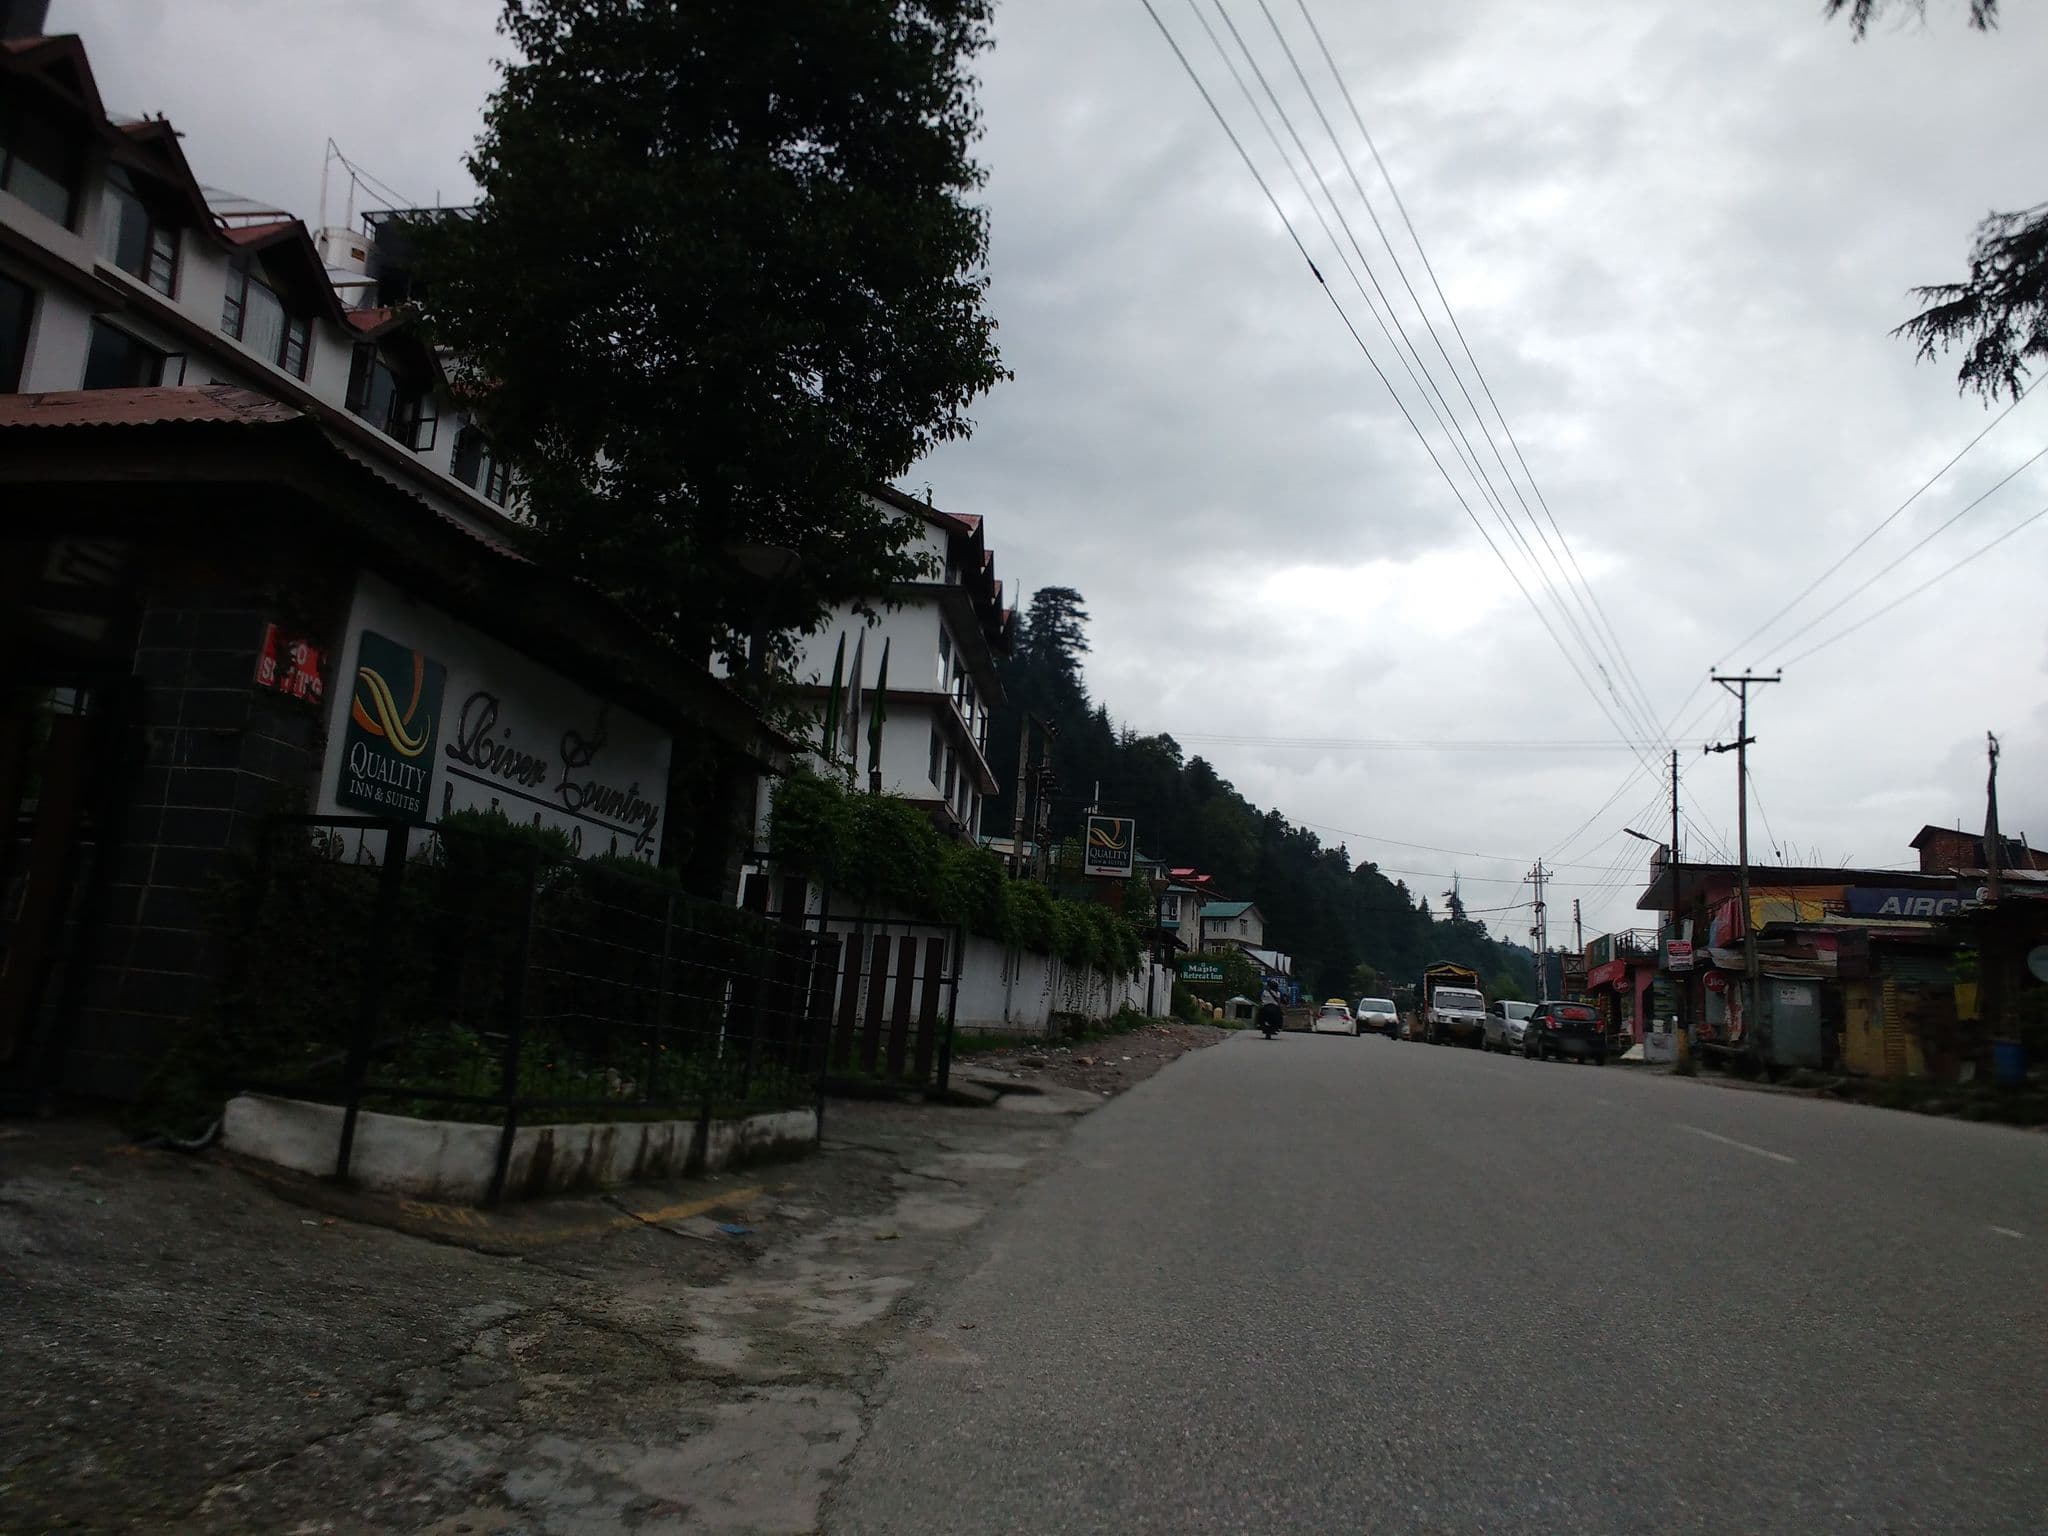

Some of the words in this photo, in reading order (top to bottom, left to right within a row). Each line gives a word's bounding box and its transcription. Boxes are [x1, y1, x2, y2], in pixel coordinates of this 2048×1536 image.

[350, 740, 427, 793] QUALITY
[446, 692, 547, 787] River
[554, 704, 659, 852] Country
[350, 779, 374, 799] INN
[374, 787, 385, 802] &
[385, 790, 421, 813] SUITES
[1089, 848, 1129, 860] QUALITY
[1183, 971, 1210, 980] Retreat
[1210, 972, 1223, 980] Inn
[1188, 965, 1218, 974] Maple
[1710, 977, 1726, 987] Jio
